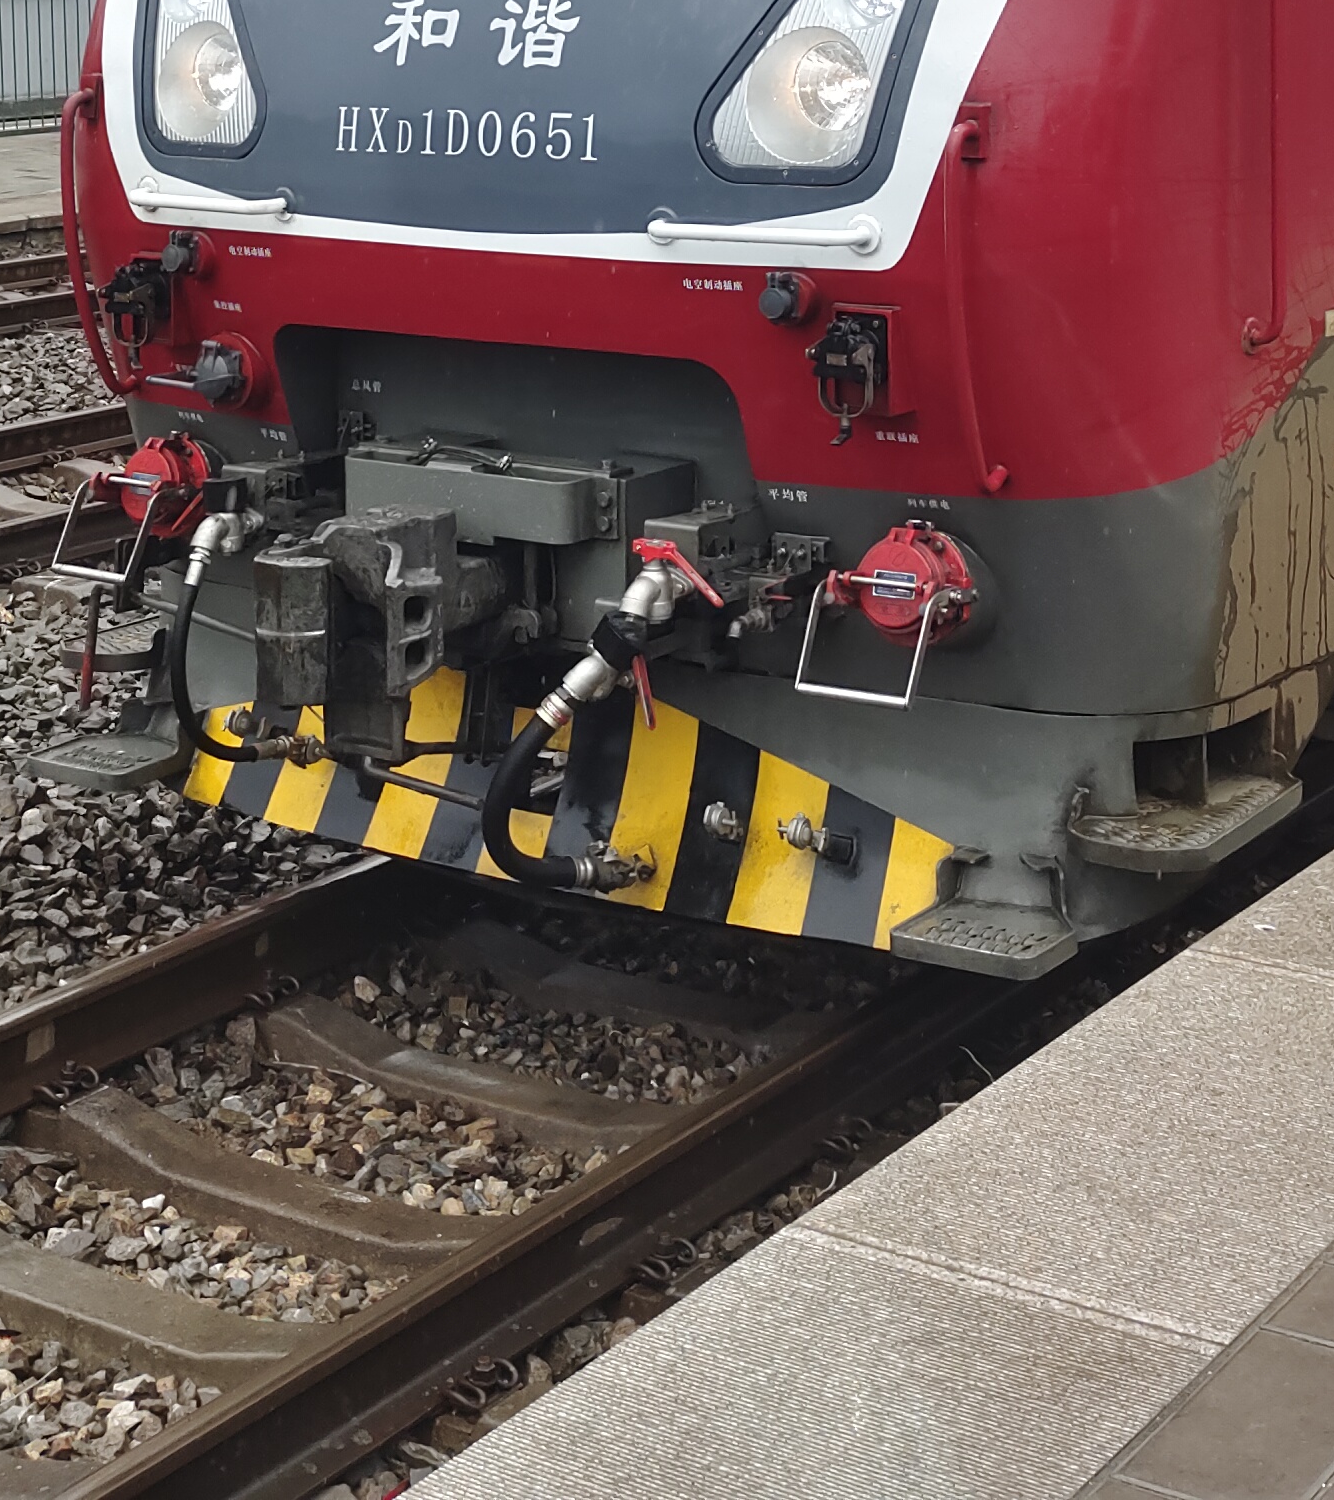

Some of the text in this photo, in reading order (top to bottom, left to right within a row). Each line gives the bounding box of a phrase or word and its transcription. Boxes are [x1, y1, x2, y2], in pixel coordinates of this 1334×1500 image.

[335, 106, 598, 161] HXD1D0651
[682, 278, 744, 291] 电空制动插座
[768, 488, 809, 503] 平均管
